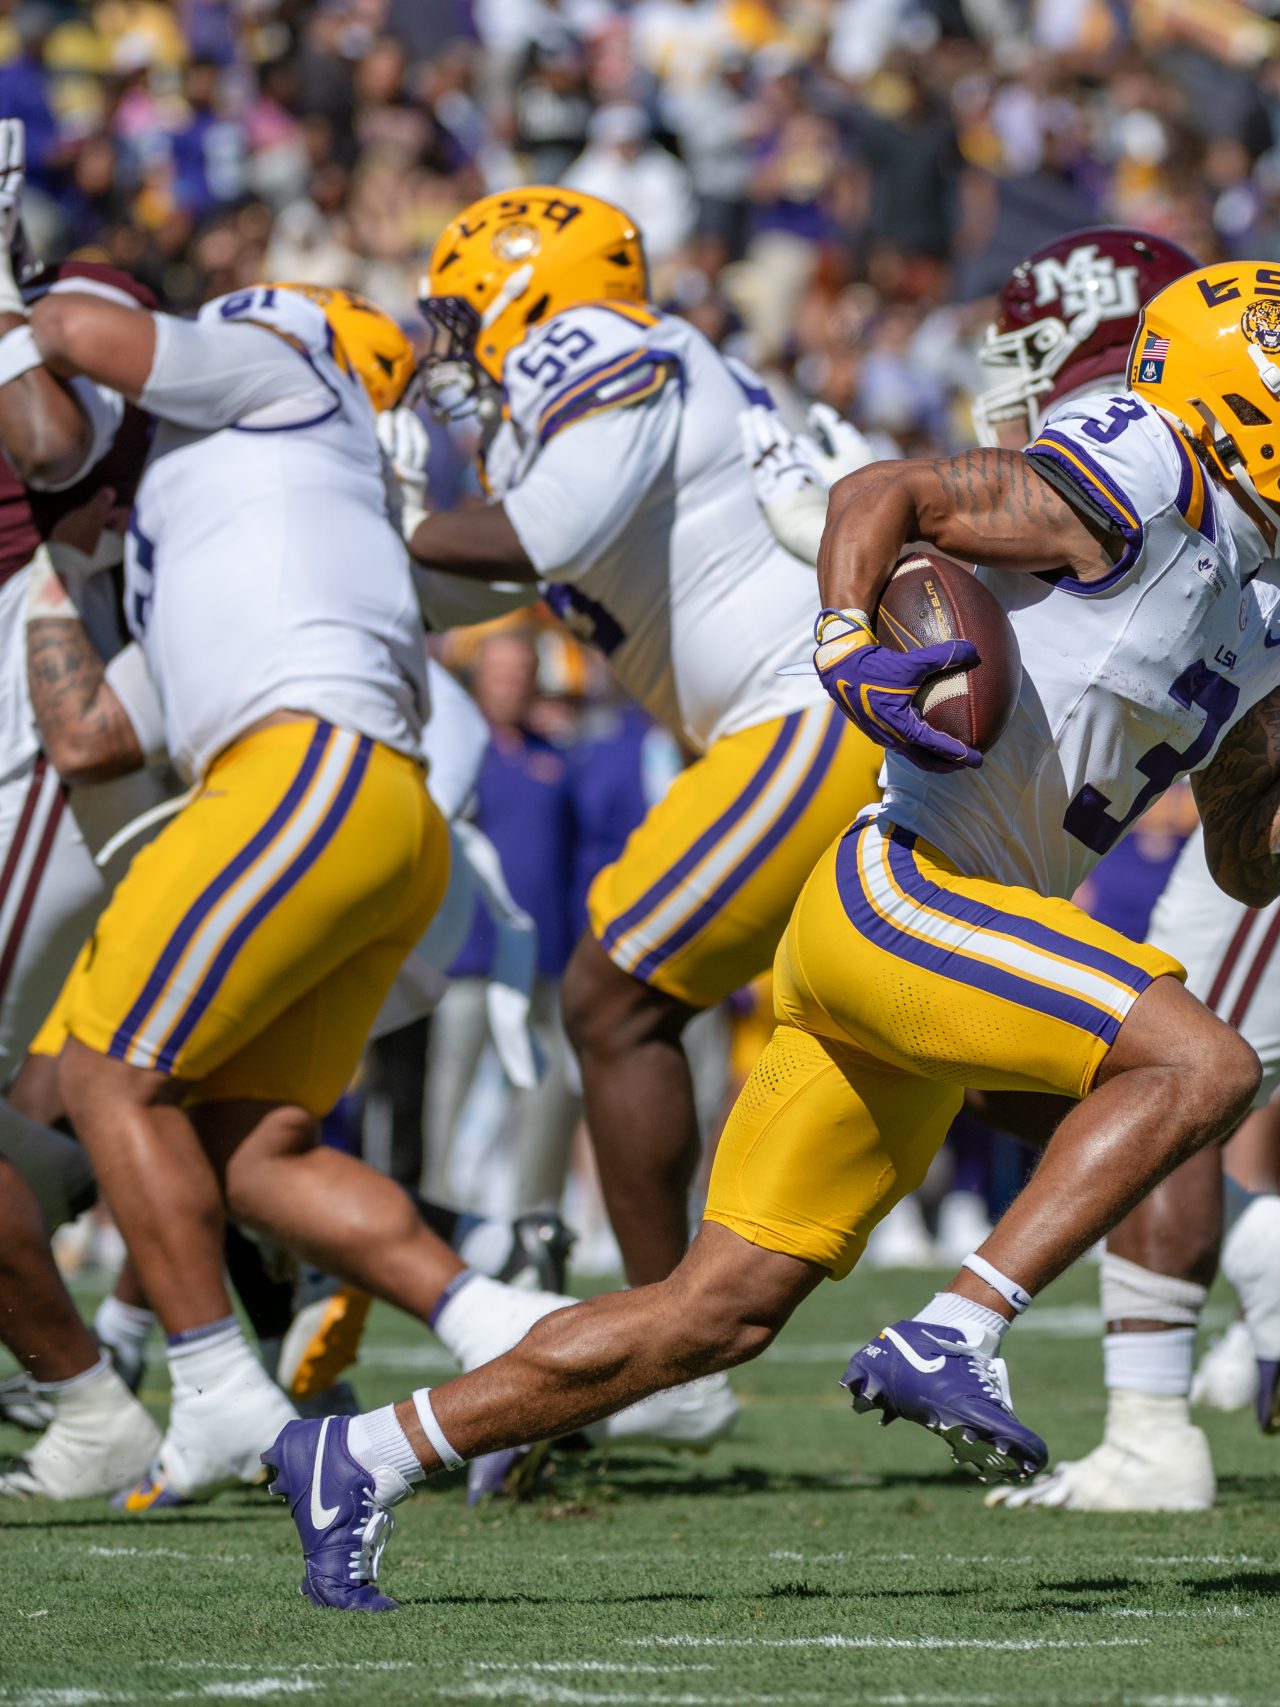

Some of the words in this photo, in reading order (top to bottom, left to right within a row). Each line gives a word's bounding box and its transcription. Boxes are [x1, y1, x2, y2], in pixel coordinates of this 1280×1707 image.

[518, 322, 596, 388] 55
[1132, 366, 1138, 383] 3
[1081, 397, 1148, 444] 3
[924, 580, 941, 607] ELITE
[1063, 659, 1240, 856] 3
